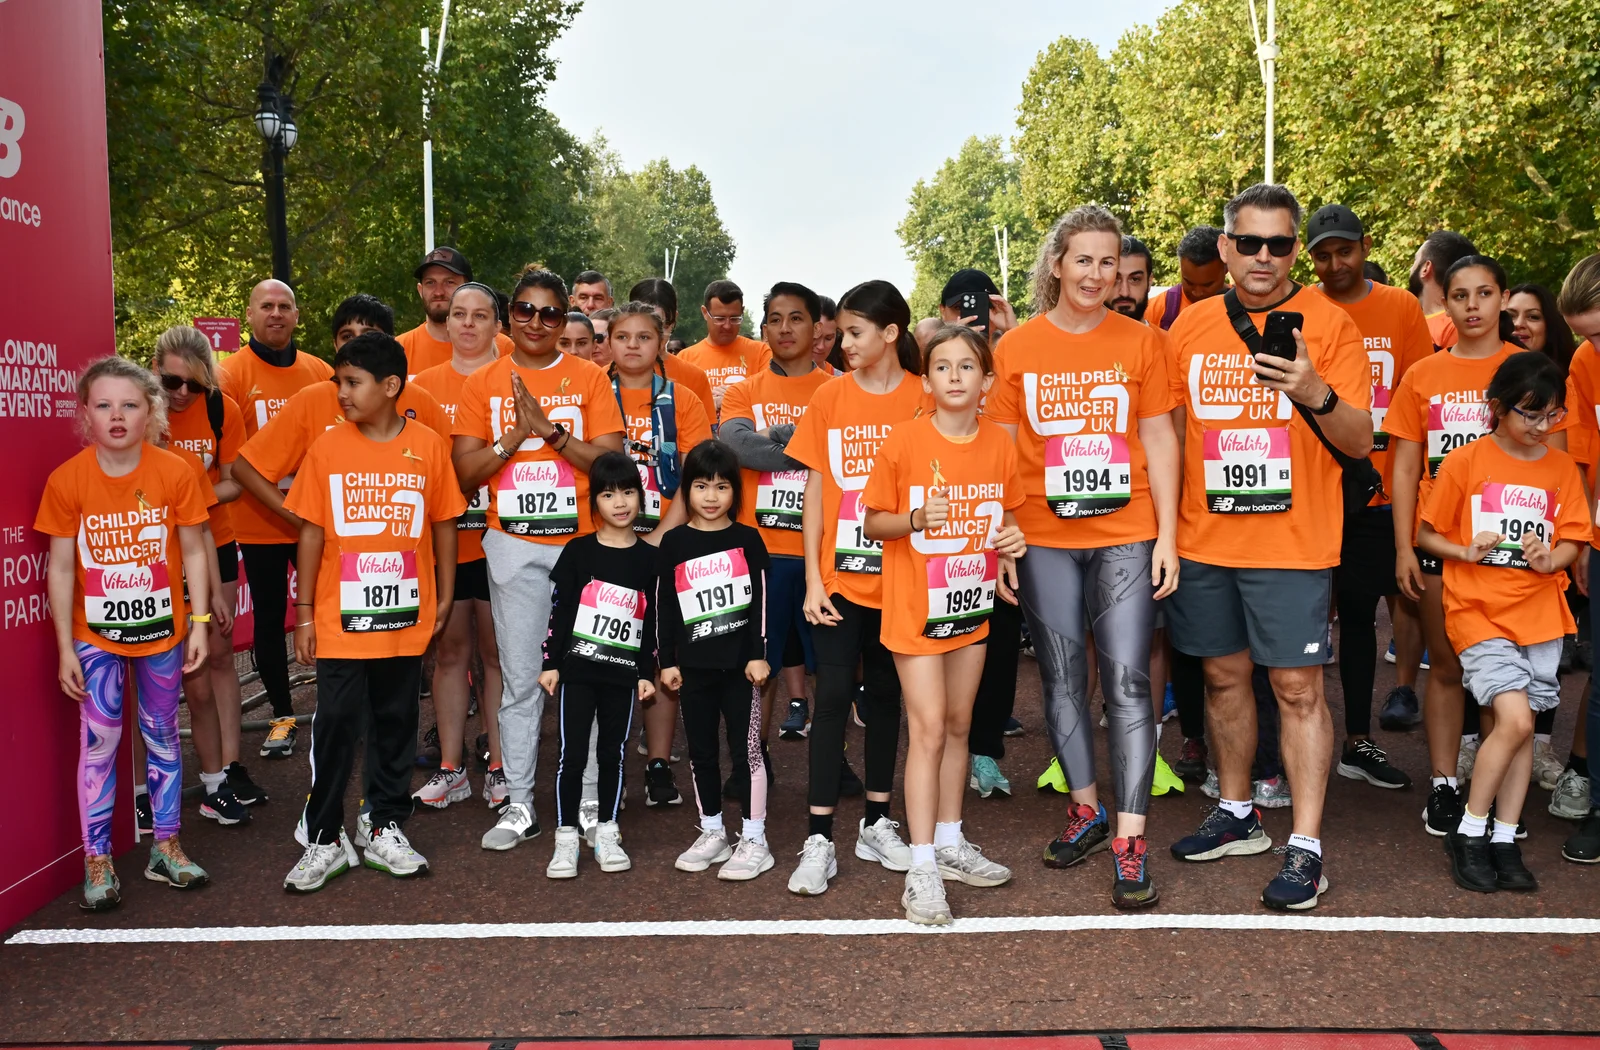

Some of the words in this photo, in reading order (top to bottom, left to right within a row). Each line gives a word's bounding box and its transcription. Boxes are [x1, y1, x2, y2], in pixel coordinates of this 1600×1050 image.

[0, 97, 26, 178] B
[0, 196, 41, 227] ance
[1205, 353, 1254, 369] CHILD
[0, 365, 77, 393] MARATHON
[1040, 370, 1128, 387] CHILDREN
[1203, 370, 1244, 385] WITH
[0, 392, 52, 418] EVENTS
[503, 394, 582, 409] CDREN
[1041, 387, 1083, 402] WITH
[1201, 387, 1275, 403] CANCER
[765, 403, 808, 417] CHILD
[1041, 401, 1114, 419] CANCER
[1249, 404, 1273, 420] UK
[1444, 405, 1487, 427] Vitality
[844, 425, 892, 440] CHILD
[1091, 418, 1114, 433] UK
[1064, 438, 1110, 462] Vitality
[1220, 432, 1268, 457] Vitality
[1441, 433, 1487, 454] 206
[514, 463, 558, 486] Vitality
[845, 459, 874, 474] CAN
[1223, 464, 1267, 488] 1991
[345, 472, 426, 490] CHILDREN
[1063, 469, 1111, 492] 1994
[346, 489, 386, 503] WITH
[771, 489, 804, 510] 1795
[928, 484, 1003, 500] CHILDREN
[1504, 487, 1546, 516] Vitality
[347, 505, 411, 520] CANCER
[517, 492, 558, 514] 1872
[949, 503, 969, 518] TH
[1235, 504, 1250, 512] new
[1252, 504, 1285, 512] balance
[86, 505, 168, 530] CHILDREN
[2, 526, 25, 545] THE
[88, 529, 132, 547] WITH
[391, 523, 409, 537] UK
[545, 526, 574, 534] balance
[1500, 519, 1545, 543] 1969
[93, 541, 160, 563] CANCER
[974, 537, 986, 551] U
[3, 551, 50, 587] ROYA
[359, 555, 403, 579] Vitality
[687, 557, 731, 580] Vitality
[947, 558, 984, 580] Vitality
[1512, 559, 1528, 567] new
[104, 571, 151, 592] Vitality
[363, 585, 399, 608] 1871
[599, 587, 637, 615] Vitality
[696, 583, 734, 612] 1797
[946, 587, 982, 614] 1992
[4, 592, 53, 630] PARK
[103, 597, 156, 621] 2088
[140, 630, 170, 641] balance
[592, 613, 632, 642] 1796
[713, 626, 730, 634] new
[952, 628, 965, 636] new
[595, 653, 609, 662] new
[609, 656, 636, 667] balance
